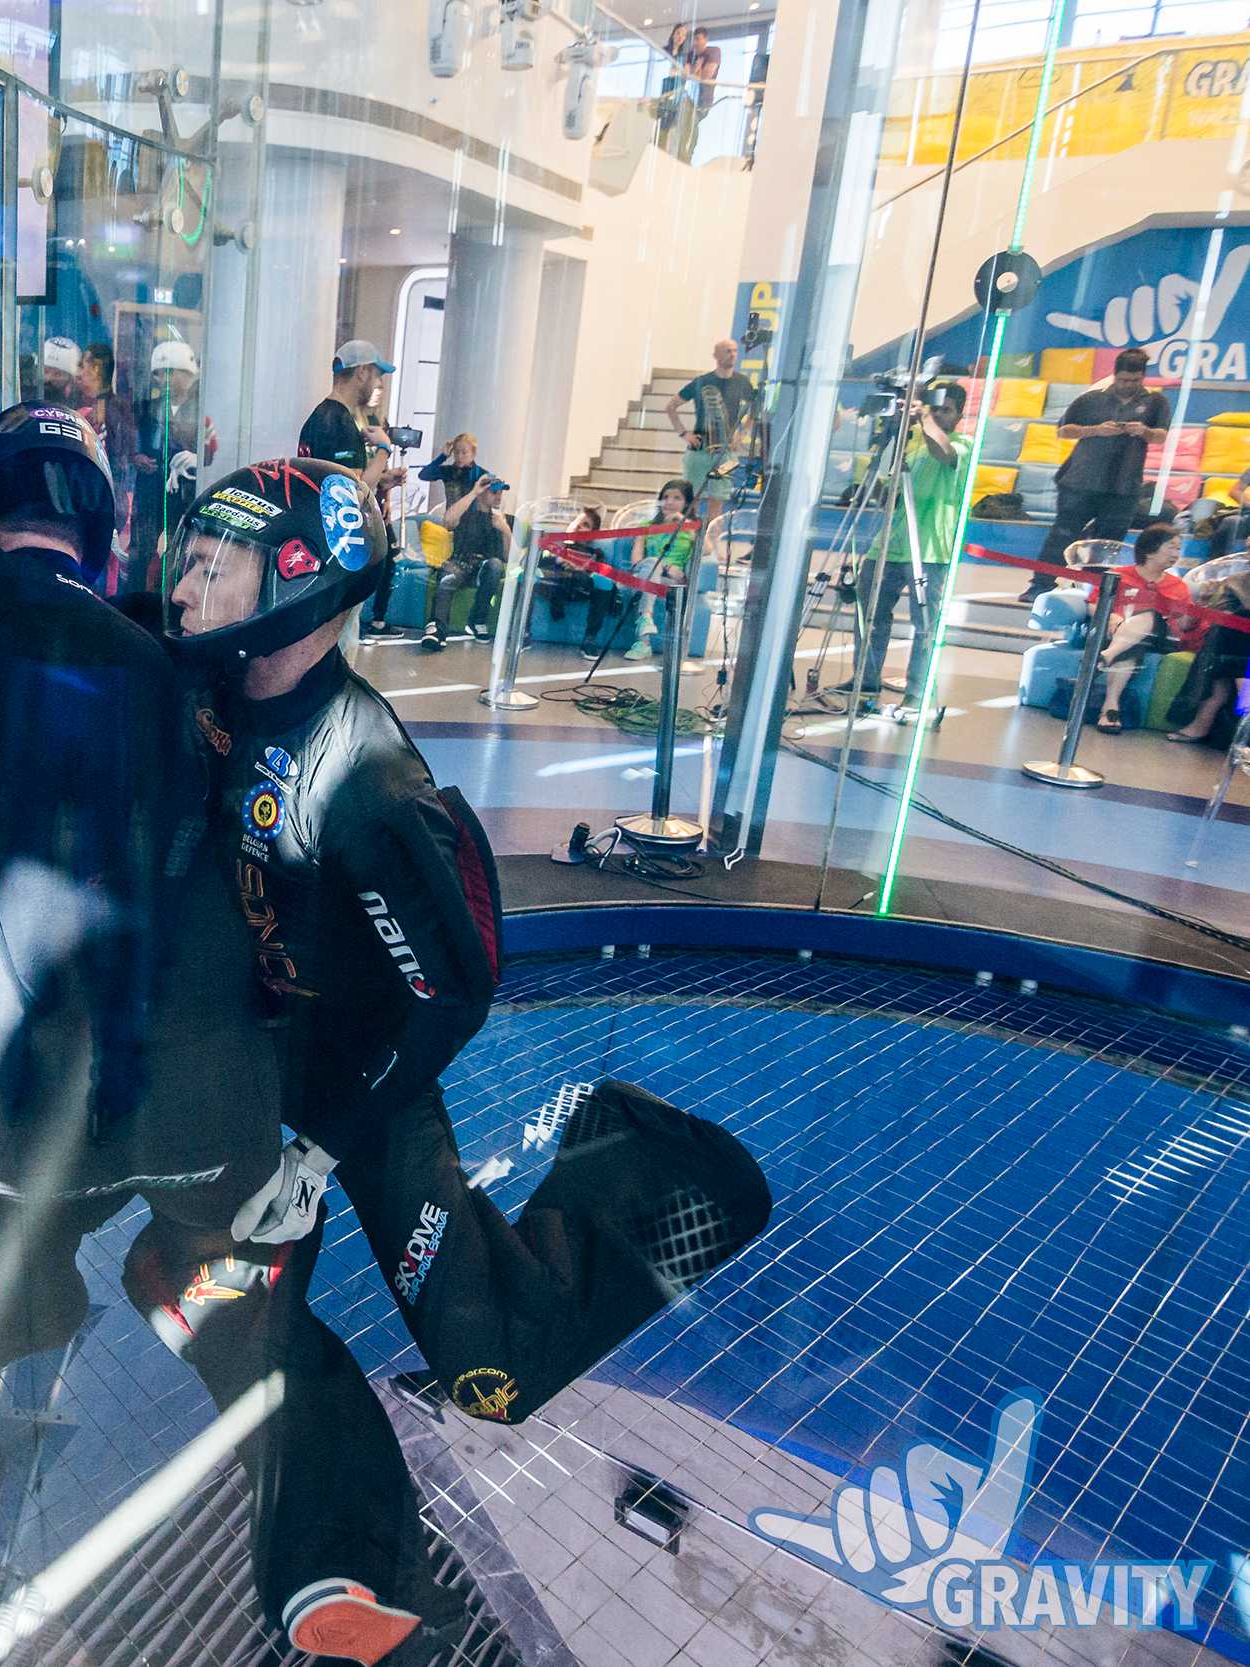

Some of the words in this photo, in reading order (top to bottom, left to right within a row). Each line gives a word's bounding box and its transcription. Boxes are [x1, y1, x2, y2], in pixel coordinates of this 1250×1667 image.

[39, 422, 83, 442] G3
[230, 489, 276, 514] Icarus
[330, 484, 366, 554] 102
[295, 1180, 317, 1213] N
[393, 1200, 442, 1297] SKYDIVE
